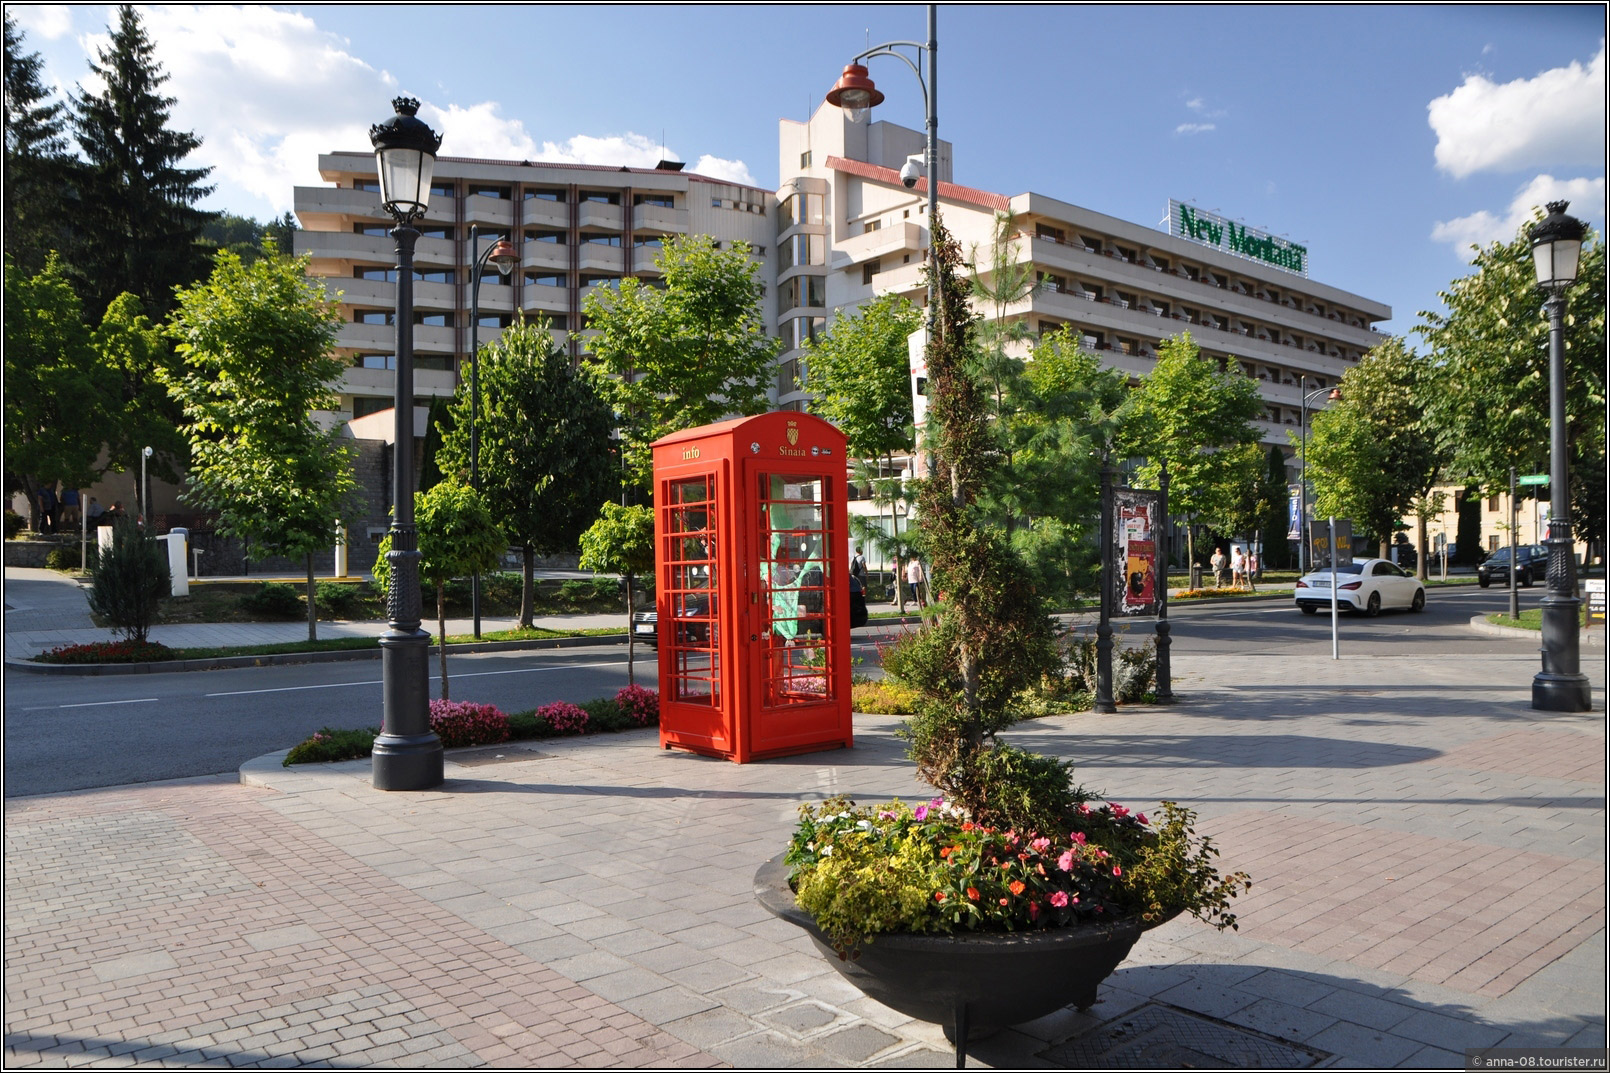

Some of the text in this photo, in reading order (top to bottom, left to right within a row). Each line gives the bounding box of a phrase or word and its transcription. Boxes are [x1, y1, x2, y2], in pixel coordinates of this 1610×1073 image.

[1179, 203, 1303, 272] New Montana
[682, 446, 701, 461] info
[779, 445, 807, 457] Sinaia
